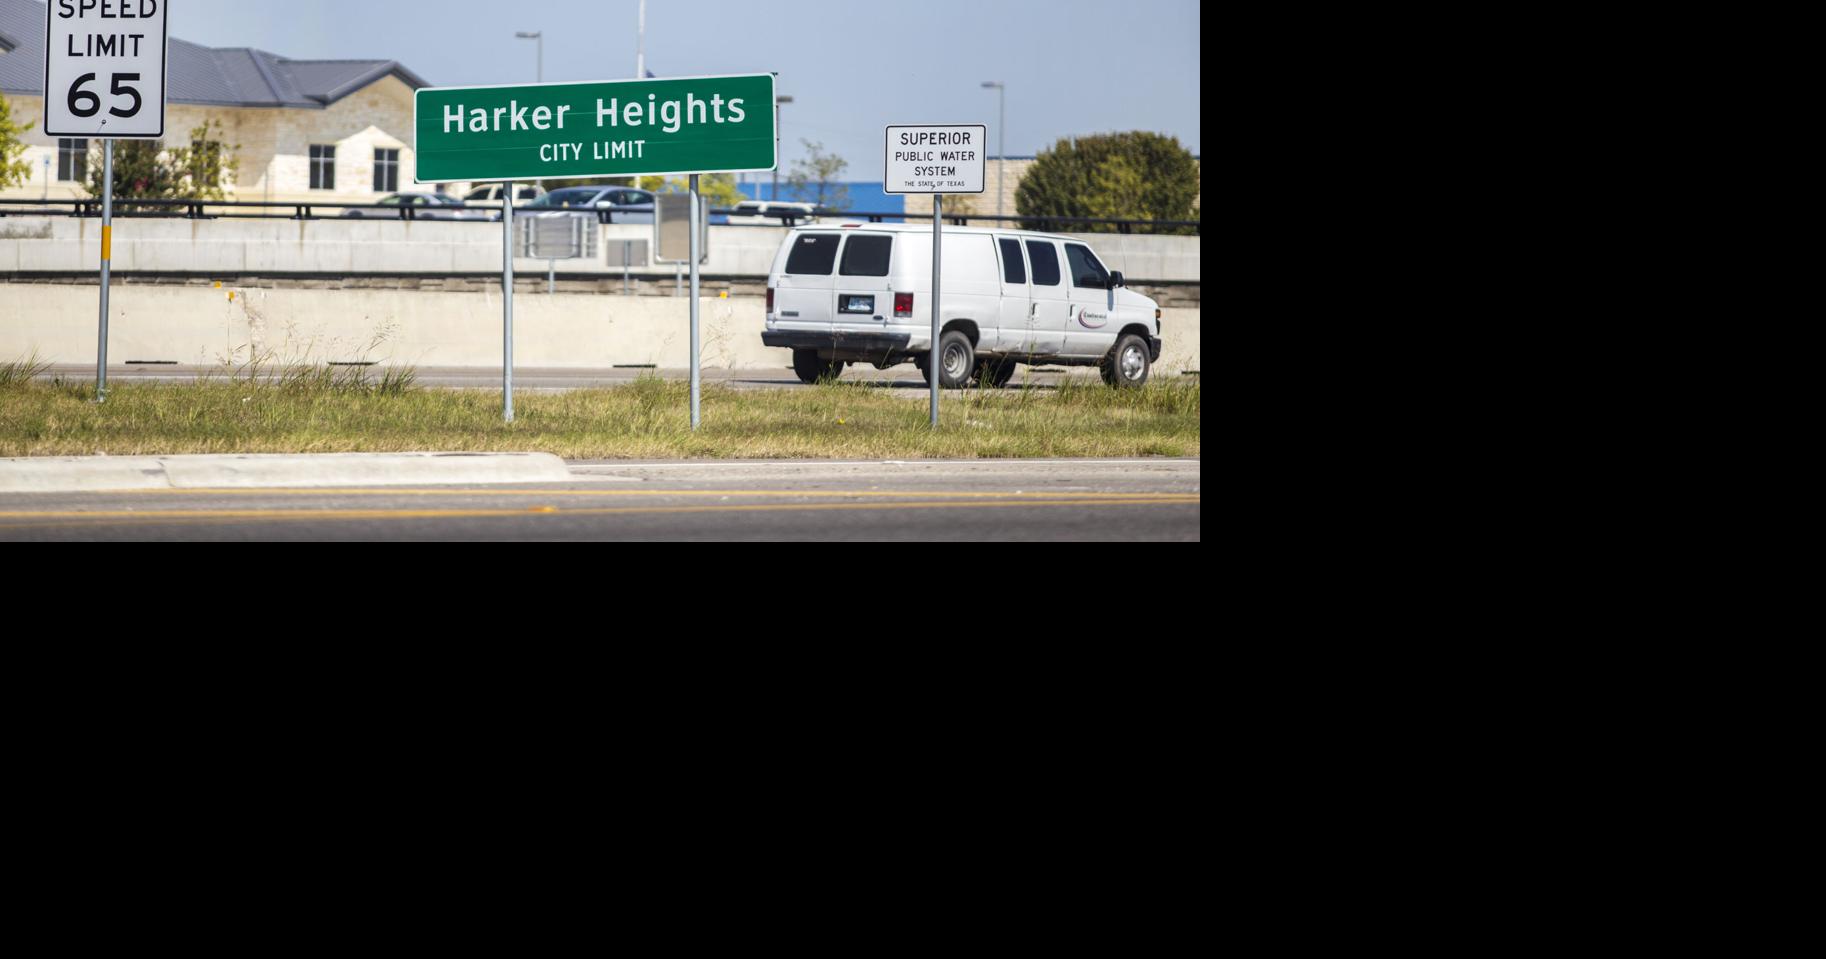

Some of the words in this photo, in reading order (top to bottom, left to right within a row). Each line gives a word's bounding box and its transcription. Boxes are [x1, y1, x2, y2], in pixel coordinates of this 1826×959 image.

[58, 0, 156, 18] SPEED
[67, 34, 144, 57] LIMIT
[67, 72, 142, 118] 65
[443, 100, 570, 133] Harker
[596, 93, 745, 133] Heights
[900, 132, 971, 146] SUPERIOR
[539, 142, 583, 162] CITY
[593, 140, 646, 160] LIMIT
[895, 151, 934, 161] PUBLIC
[940, 151, 975, 161] WATER
[914, 166, 956, 176] SYSTEM
